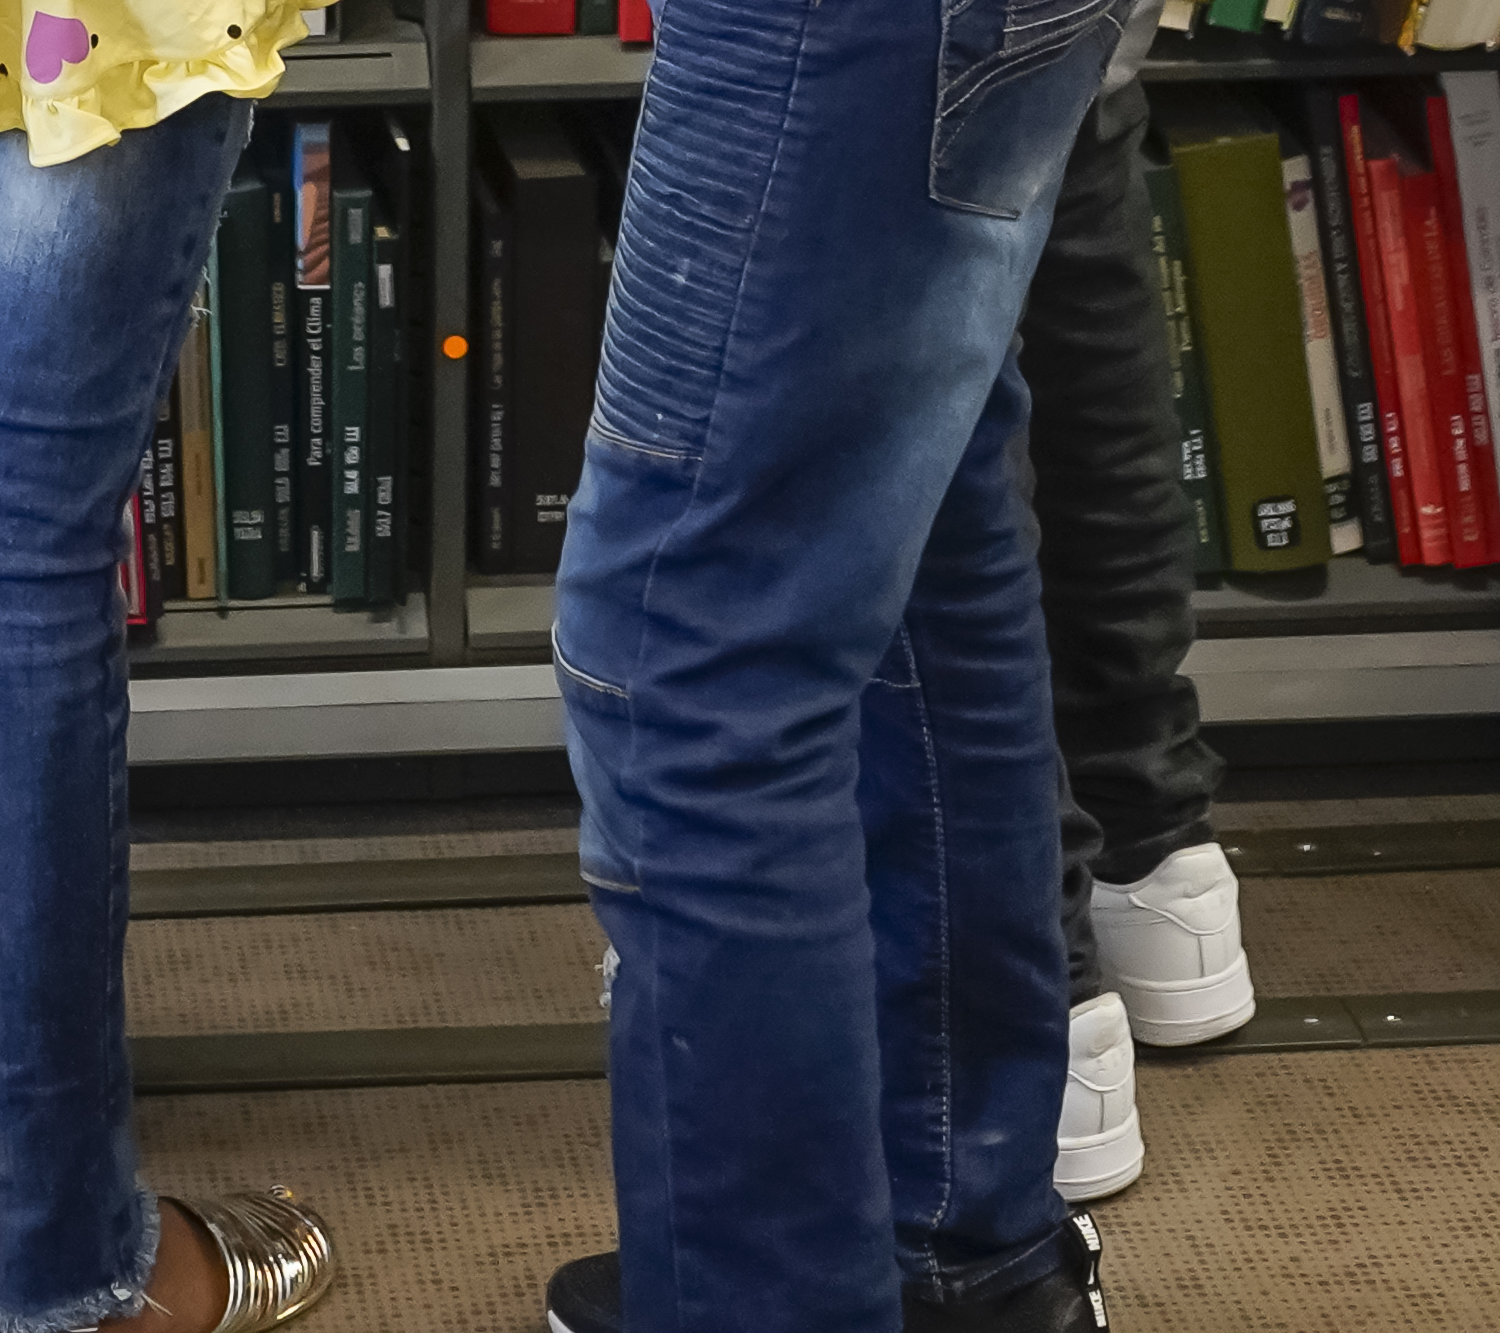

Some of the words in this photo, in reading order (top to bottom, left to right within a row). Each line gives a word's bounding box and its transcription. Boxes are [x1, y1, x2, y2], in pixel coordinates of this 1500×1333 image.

[305, 297, 322, 334] Clima
[306, 338, 322, 351] el
[307, 355, 326, 434] comprender
[307, 438, 323, 466] Para
